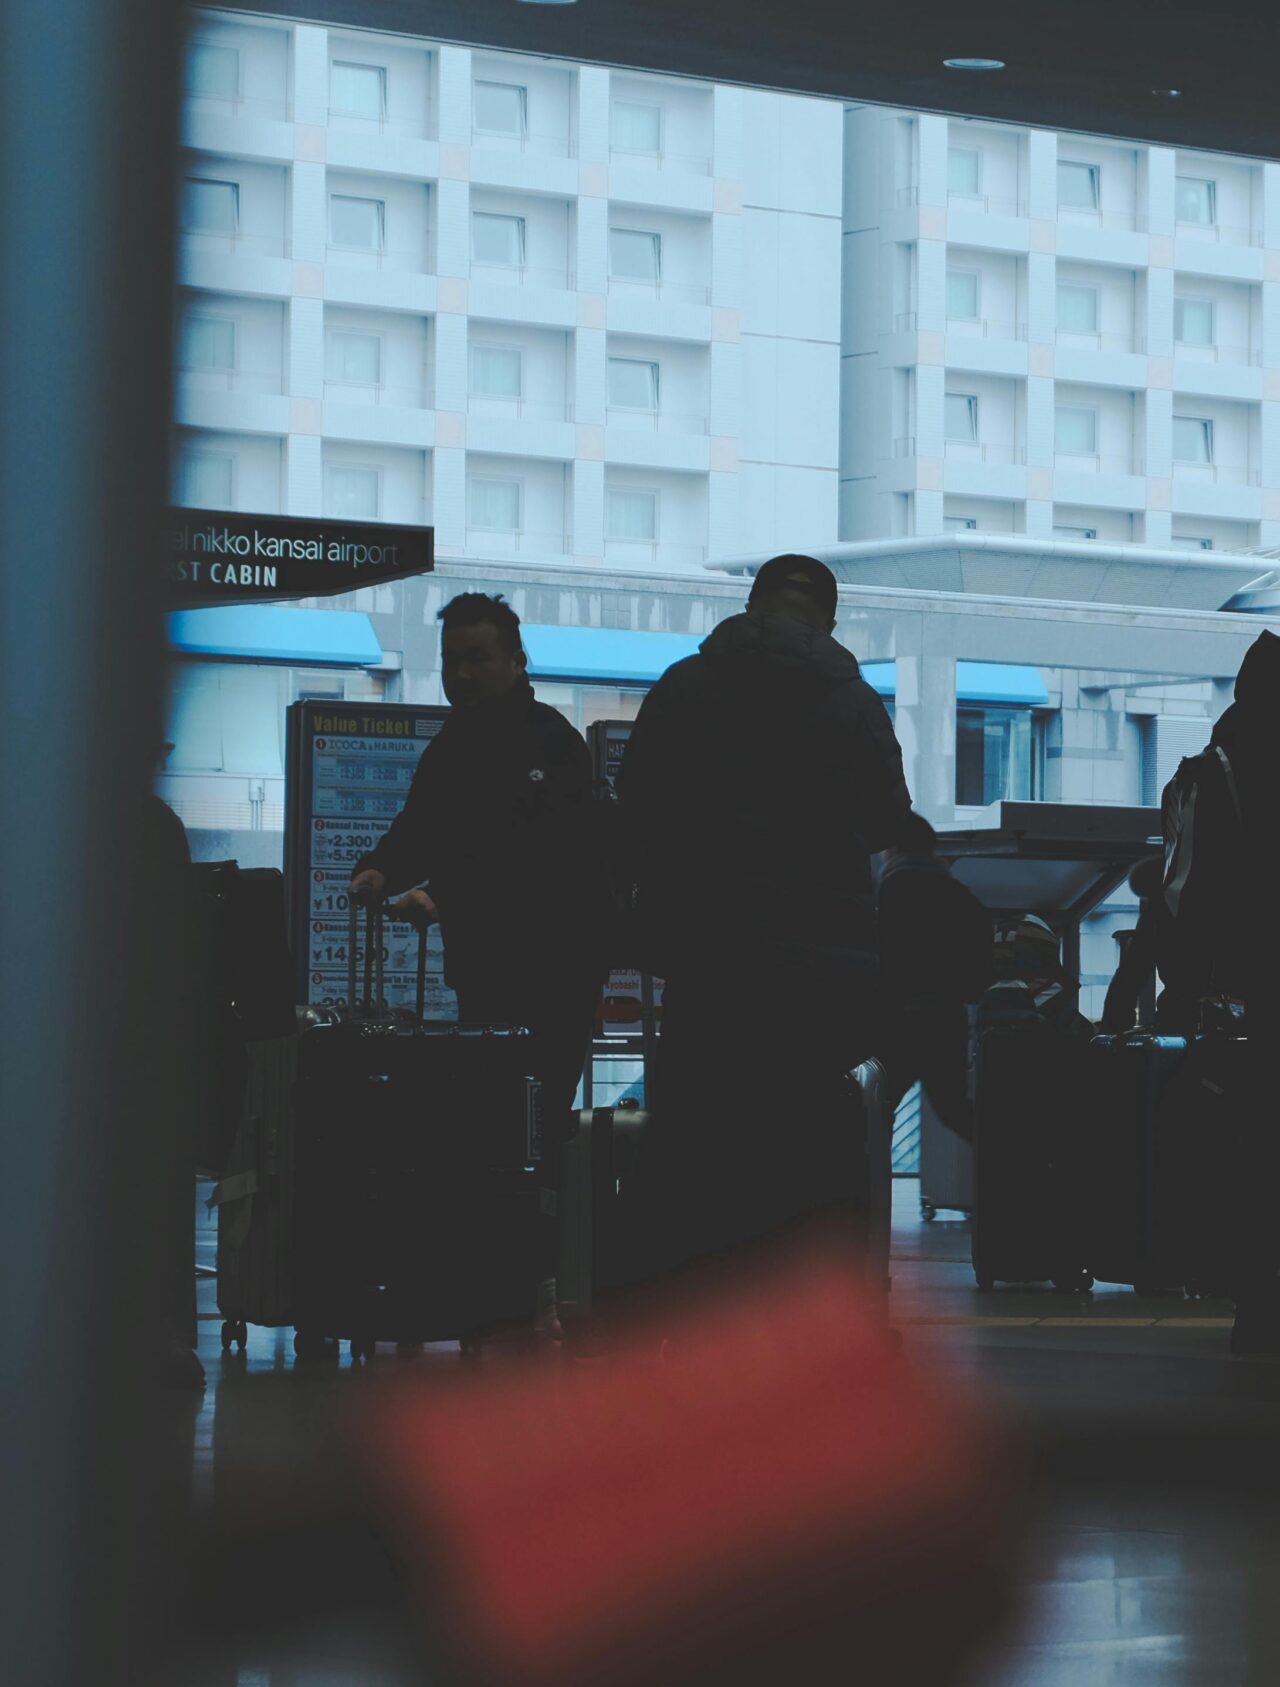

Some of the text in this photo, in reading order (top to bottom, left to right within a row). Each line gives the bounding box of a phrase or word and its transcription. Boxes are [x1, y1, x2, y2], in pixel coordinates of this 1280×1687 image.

[193, 526, 250, 555] nikko
[254, 529, 323, 560] kansai
[328, 536, 399, 569] airport
[210, 562, 277, 587] CABIN
[314, 716, 358, 733] Value
[362, 717, 410, 736] Ticket
[375, 742, 416, 752] HARUKA
